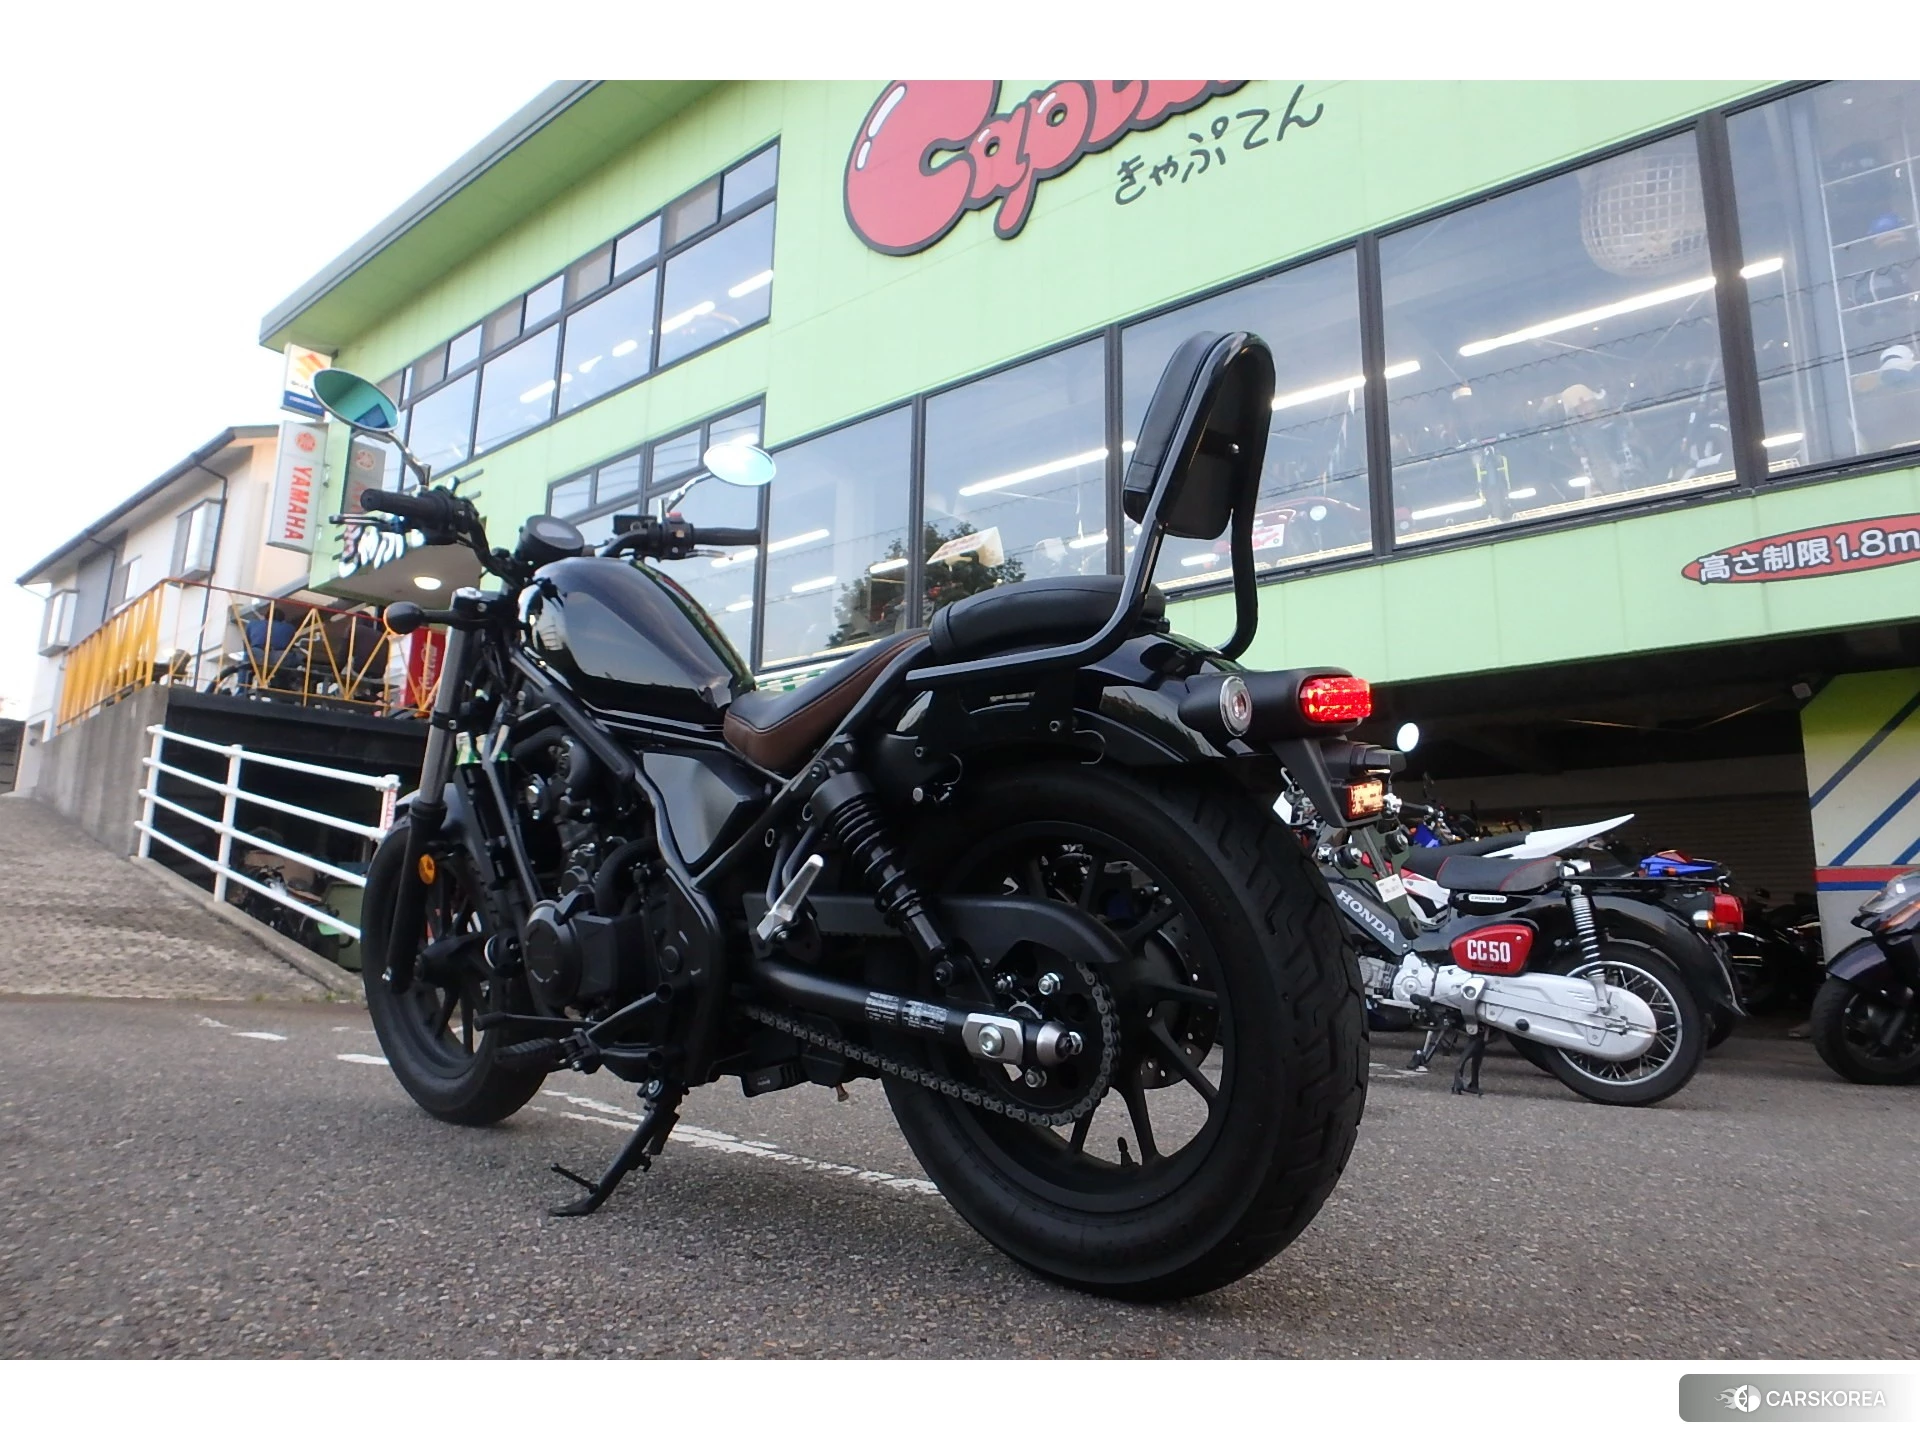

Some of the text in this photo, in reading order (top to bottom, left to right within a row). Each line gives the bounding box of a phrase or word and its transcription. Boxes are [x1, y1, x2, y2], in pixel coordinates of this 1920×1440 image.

[1115, 84, 1323, 205] きゃぷてん
[284, 466, 312, 540] YAMAHA
[1336, 889, 1395, 944] HONDA
[1467, 939, 1511, 963] CC50
